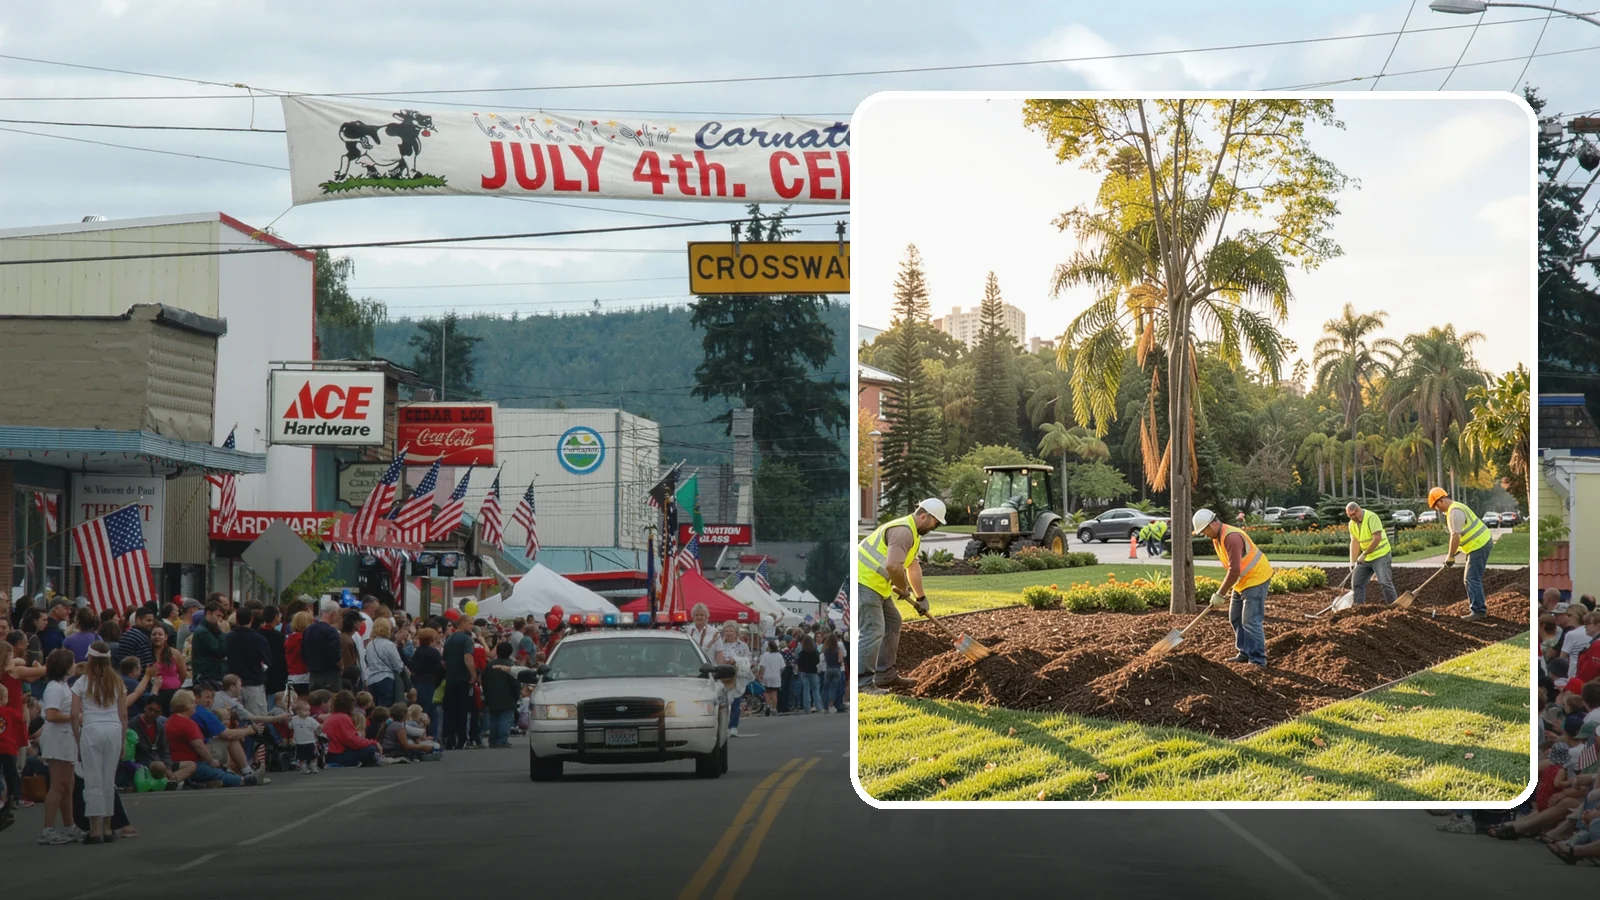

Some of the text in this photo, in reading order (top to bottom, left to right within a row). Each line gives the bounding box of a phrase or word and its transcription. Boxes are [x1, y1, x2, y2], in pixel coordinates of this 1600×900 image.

[481, 141, 605, 193] JULY
[632, 150, 746, 198] 4th.
[696, 254, 850, 280] CROSSWA
[283, 380, 373, 420] ACE
[406, 409, 452, 422] CEDAR
[283, 420, 371, 436] Hardware
[416, 428, 477, 447] Coca-Cola
[96, 485, 124, 495] Vincent
[126, 486, 136, 495] de
[138, 486, 155, 495] Paul
[688, 526, 741, 535] CRNATION
[699, 535, 730, 543] GLASS
